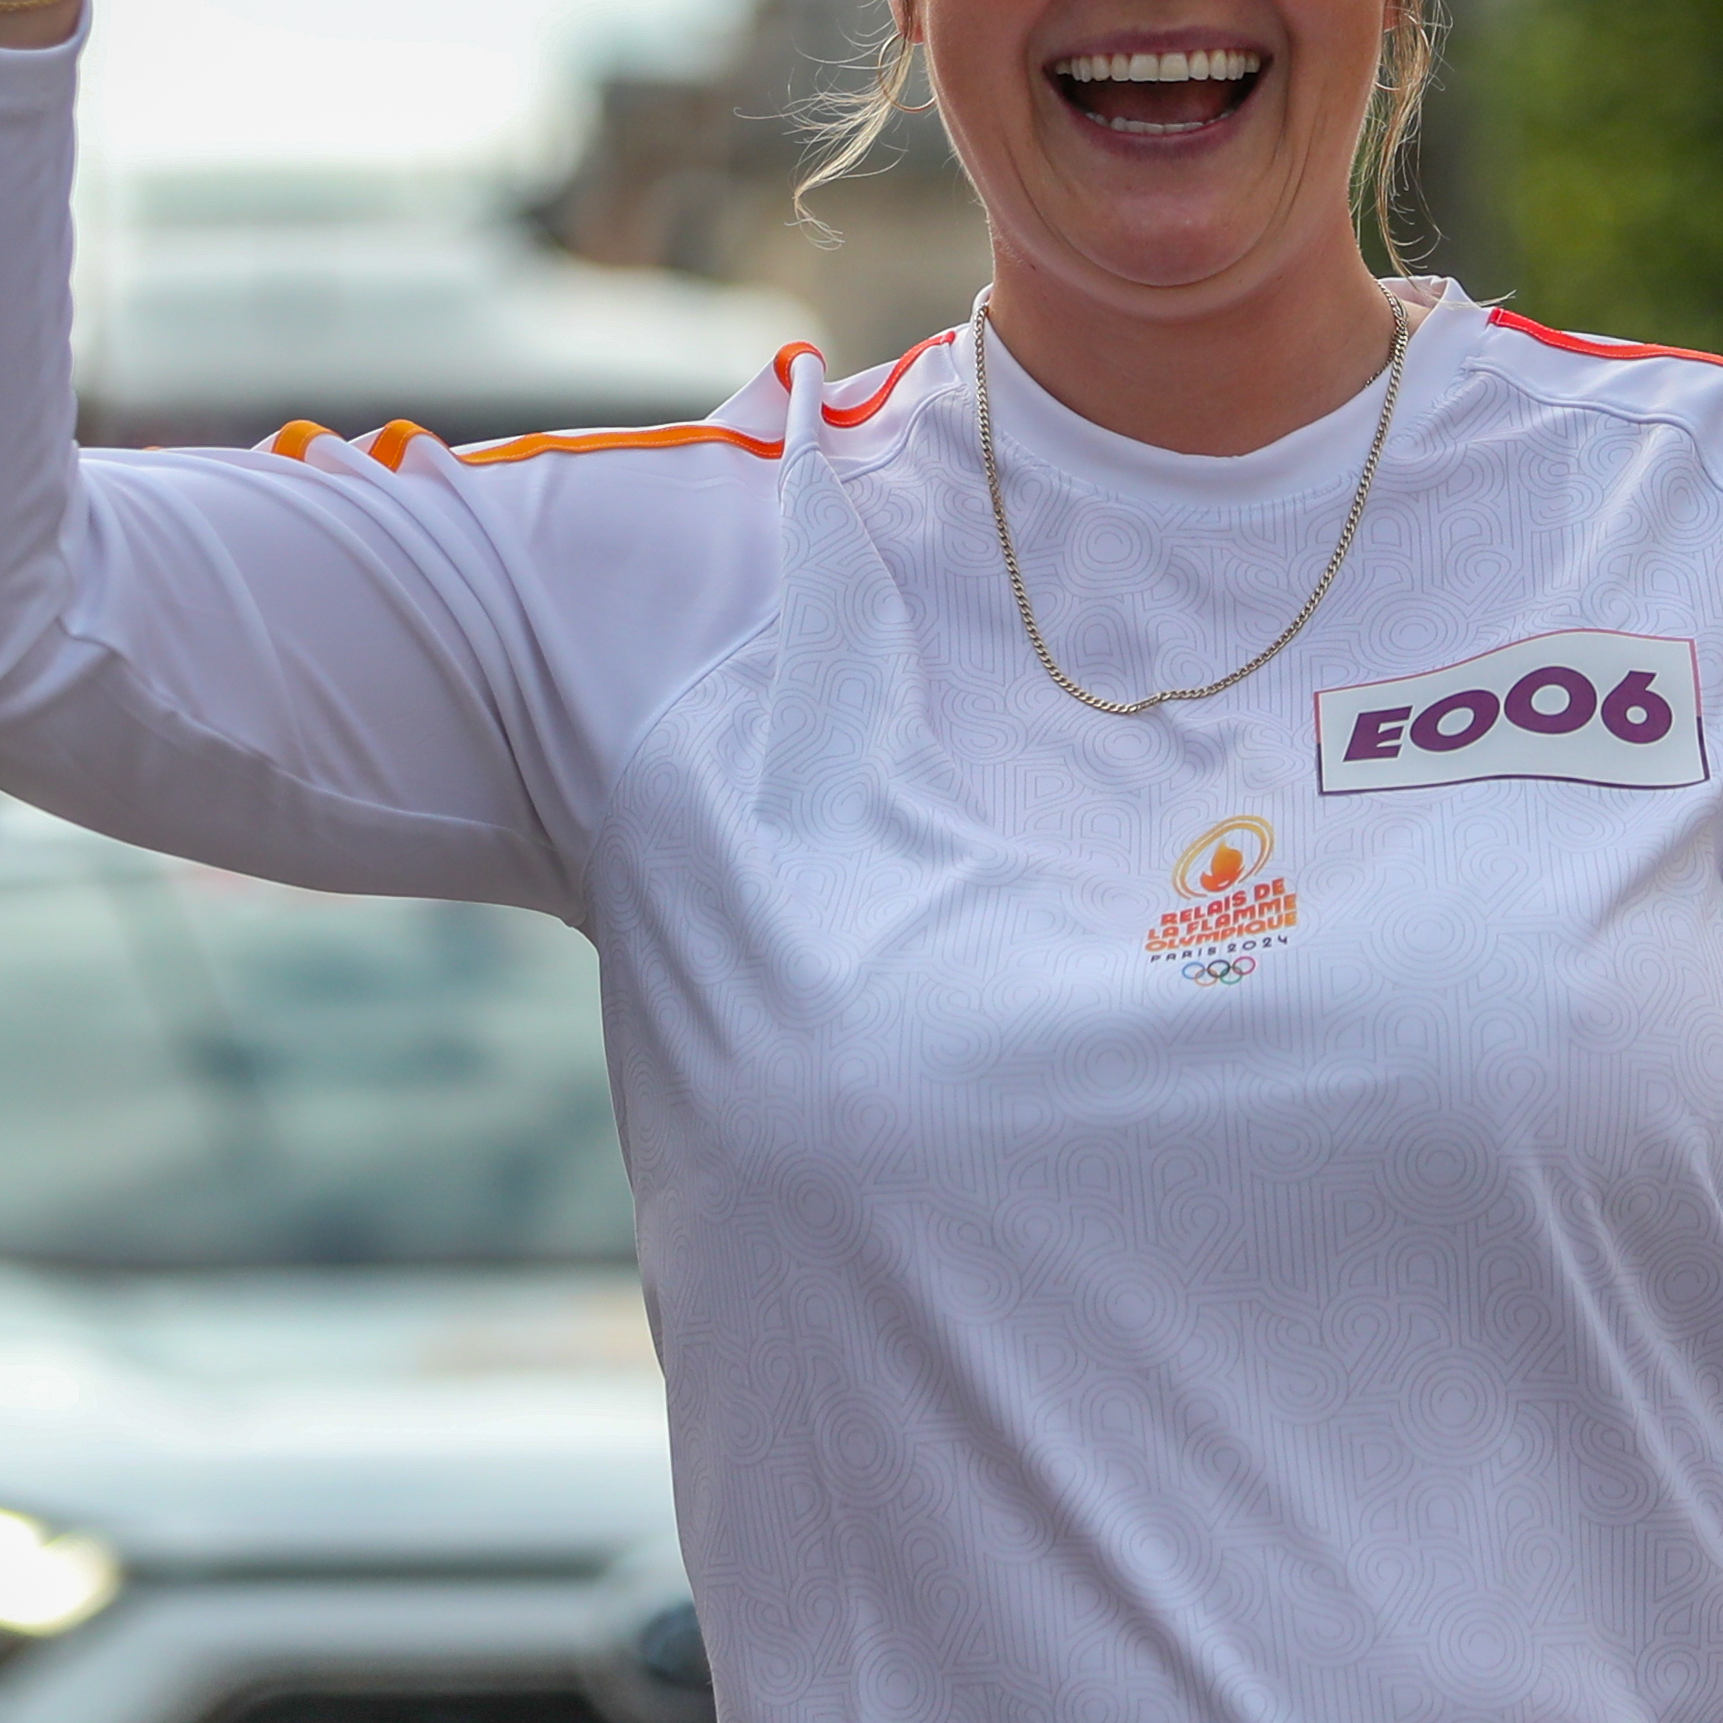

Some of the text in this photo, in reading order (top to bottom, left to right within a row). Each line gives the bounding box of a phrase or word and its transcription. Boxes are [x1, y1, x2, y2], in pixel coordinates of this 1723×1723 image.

[1147, 893, 1297, 940] LA FLAMME
[1160, 877, 1285, 926] RELAIS DE
[1144, 910, 1298, 952] OLYMPIQUE
[1149, 934, 1289, 963] PARIS 2024
